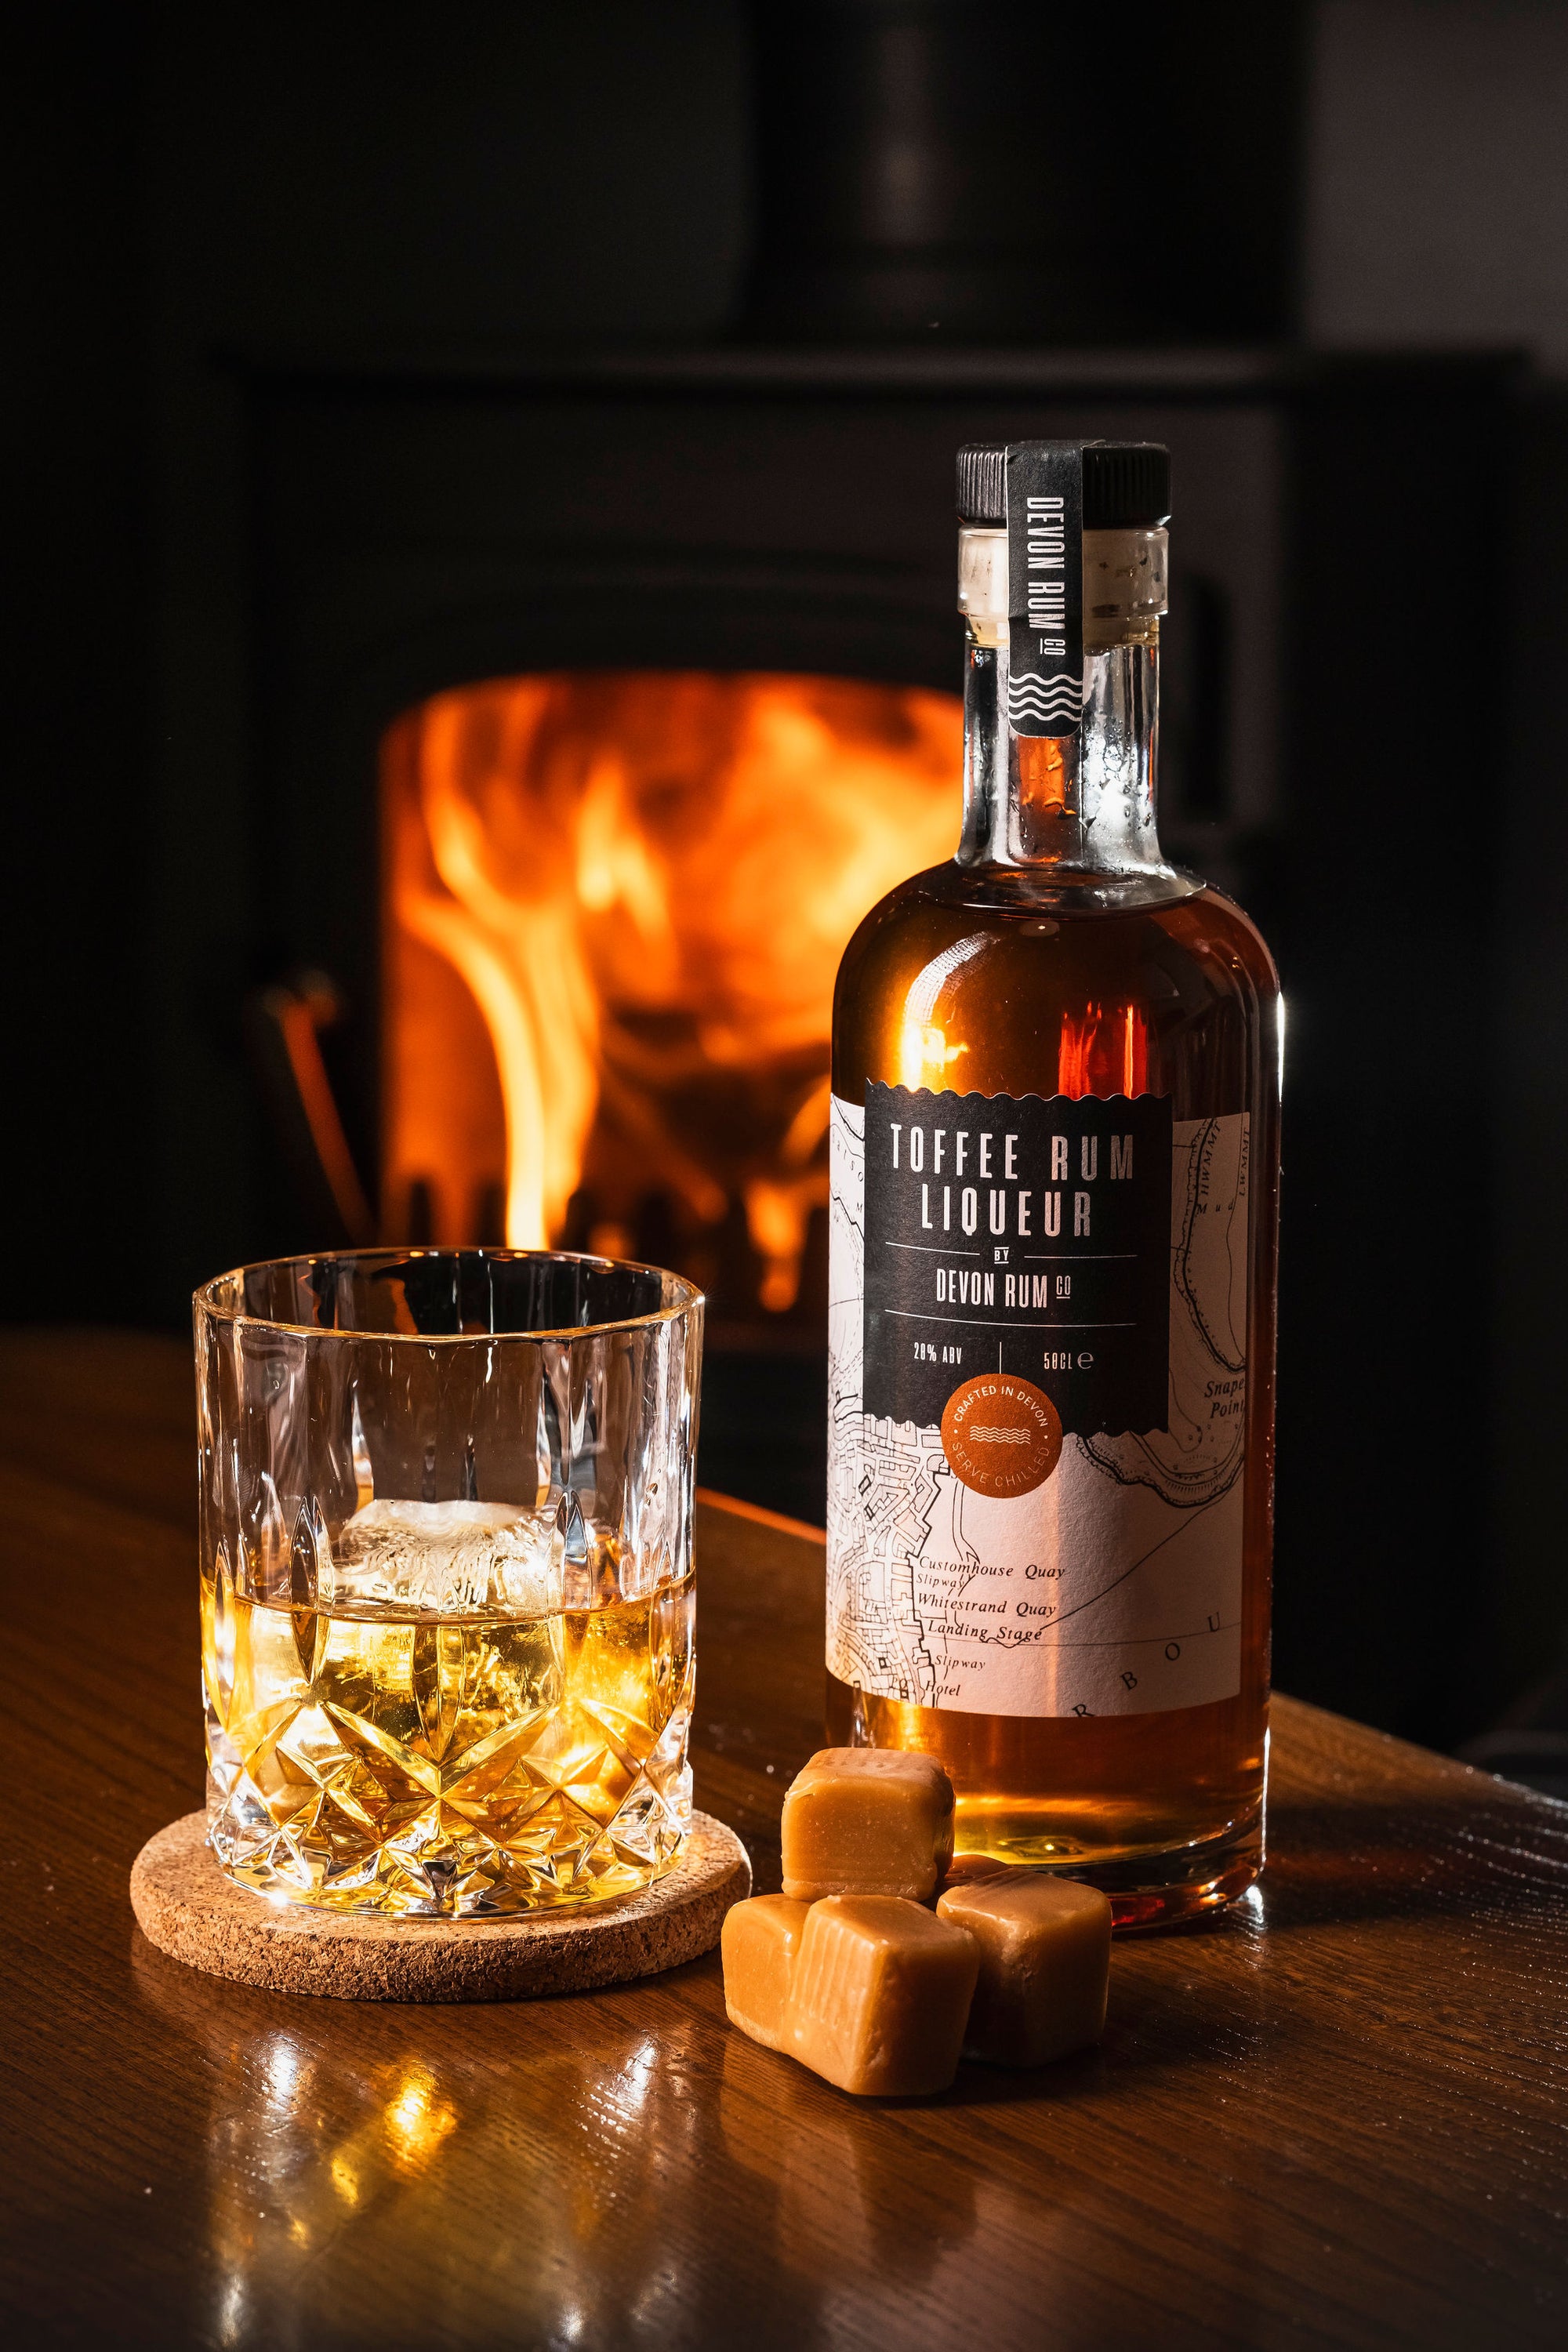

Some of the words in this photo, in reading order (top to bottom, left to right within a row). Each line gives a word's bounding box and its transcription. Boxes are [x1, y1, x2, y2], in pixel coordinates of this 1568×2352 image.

[1027, 496, 1065, 569] DEVON
[1028, 582, 1065, 630] RUM
[1044, 638, 1066, 655] CO
[891, 1123, 1018, 1179] TOFFEE
[1051, 1134, 1134, 1181] RUM
[922, 1183, 1091, 1236] LIQUEUR
[994, 1250, 1009, 1261] BY
[936, 1269, 994, 1306] DEVON
[1005, 1274, 1047, 1308] RUM
[1056, 1275, 1071, 1295] CO
[914, 1341, 937, 1362] 20%
[942, 1347, 962, 1364] ABV
[1044, 1352, 1073, 1370] 50CL
[954, 1385, 996, 1421] CRAFTED
[1001, 1385, 1014, 1396] IN
[1017, 1391, 1048, 1427] DEVON
[953, 1442, 990, 1484] SERVE
[995, 1447, 1050, 1487] CHILLED
[920, 1555, 1014, 1577] Customhouse
[1025, 1564, 1065, 1581] Quay
[916, 1573, 965, 1590] Slipway
[918, 1592, 1007, 1613] Whitestrand
[1016, 1602, 1057, 1618] Quay
[928, 1620, 988, 1642] Landing
[996, 1626, 1043, 1642] Stage
[935, 1654, 986, 1671] Slipway
[925, 1680, 961, 1697] Hotel
